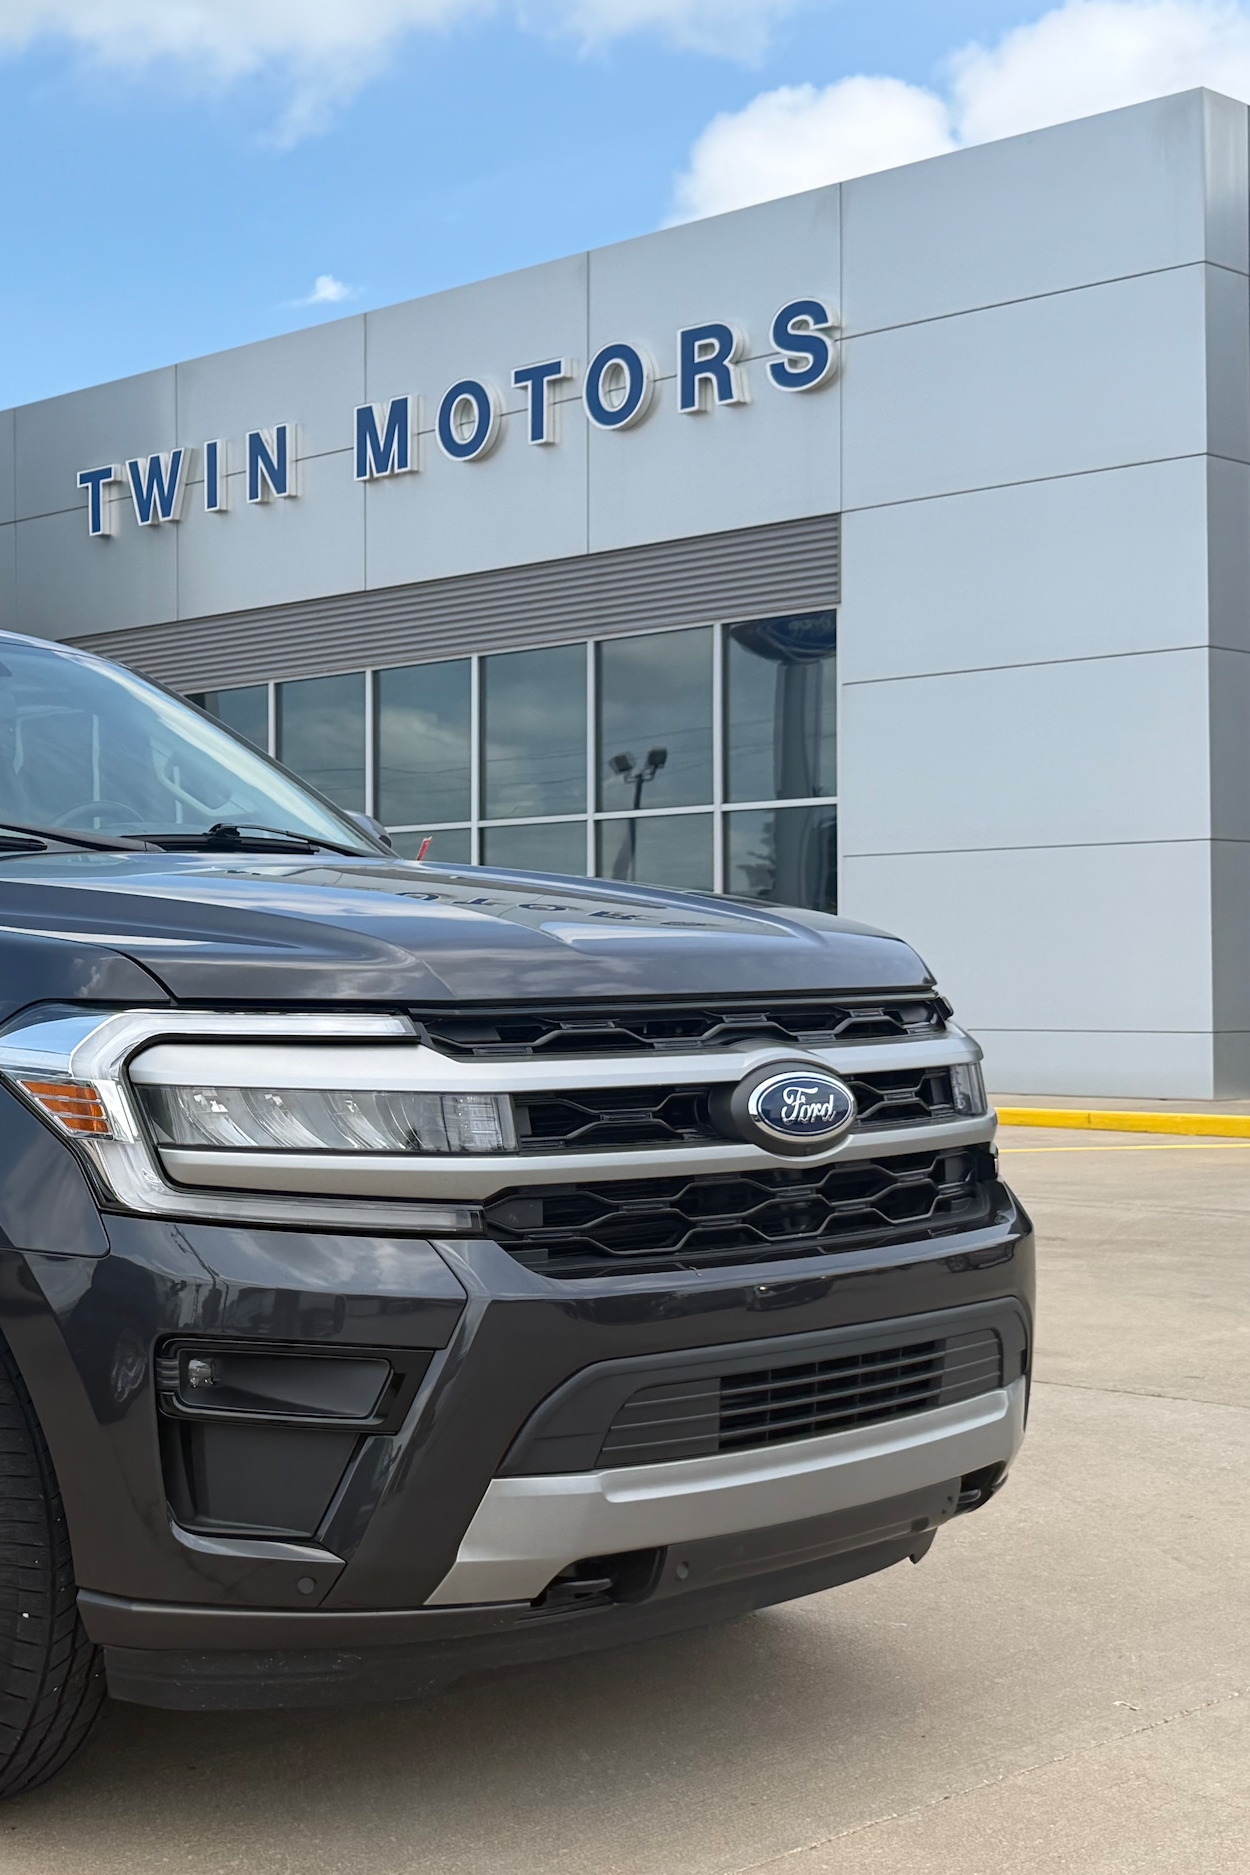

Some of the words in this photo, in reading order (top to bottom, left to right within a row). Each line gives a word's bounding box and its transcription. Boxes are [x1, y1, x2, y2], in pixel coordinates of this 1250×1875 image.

[77, 422, 297, 537] TWIN
[354, 297, 835, 481] MOTORS
[780, 1086, 837, 1125] Ford
